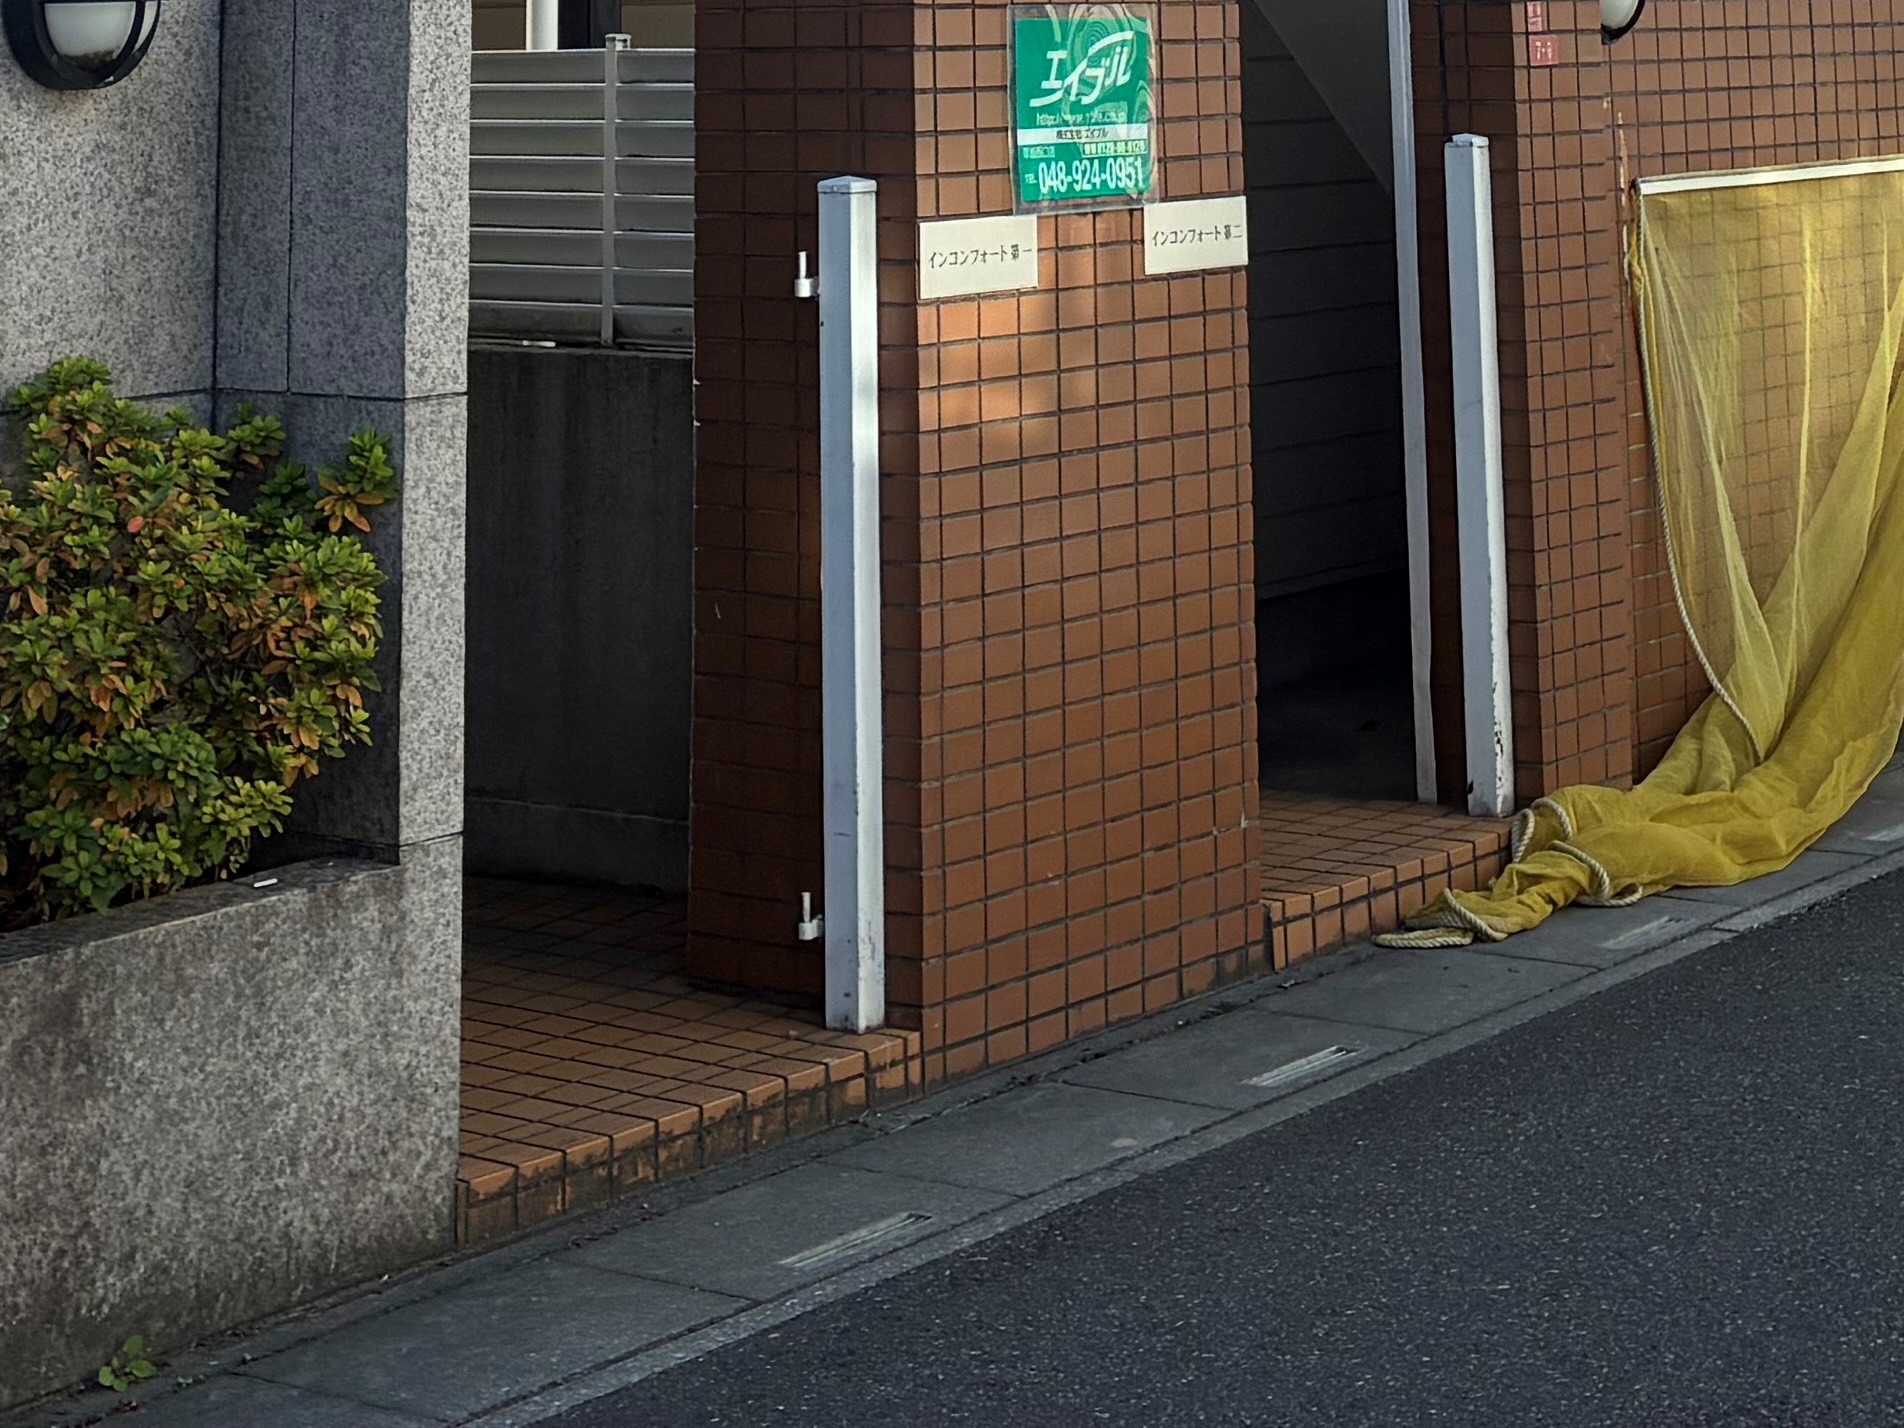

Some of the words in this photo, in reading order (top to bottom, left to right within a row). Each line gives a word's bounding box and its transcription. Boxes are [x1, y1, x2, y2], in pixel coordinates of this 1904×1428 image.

[1029, 31, 1135, 107] エイブル
[1038, 156, 1144, 193] 048-924-0951
